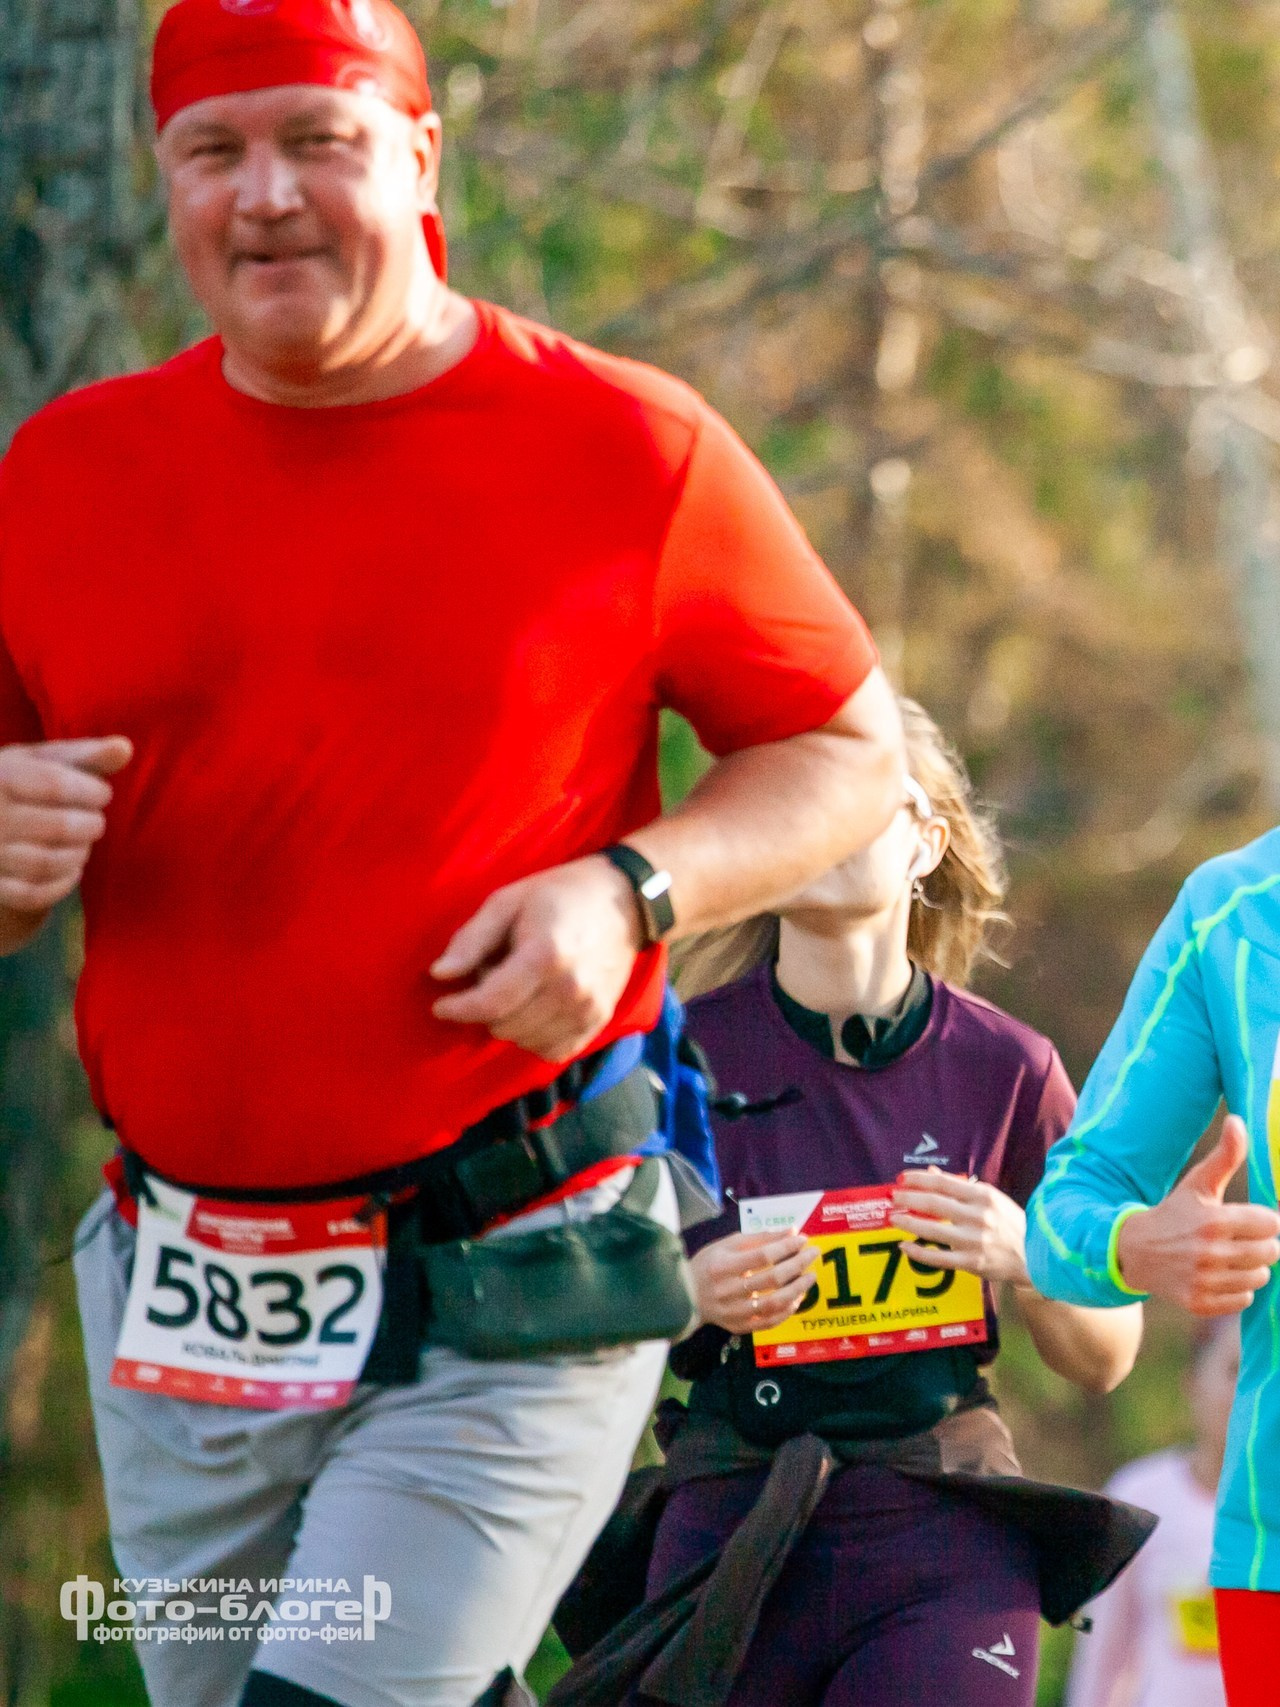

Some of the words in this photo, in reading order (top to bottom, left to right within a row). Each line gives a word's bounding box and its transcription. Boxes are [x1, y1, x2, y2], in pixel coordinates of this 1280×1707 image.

[146, 1245, 365, 1345] 5832
[801, 1312, 878, 1330] ТУРУШЕВА
[880, 1304, 939, 1321] МАРИНА
